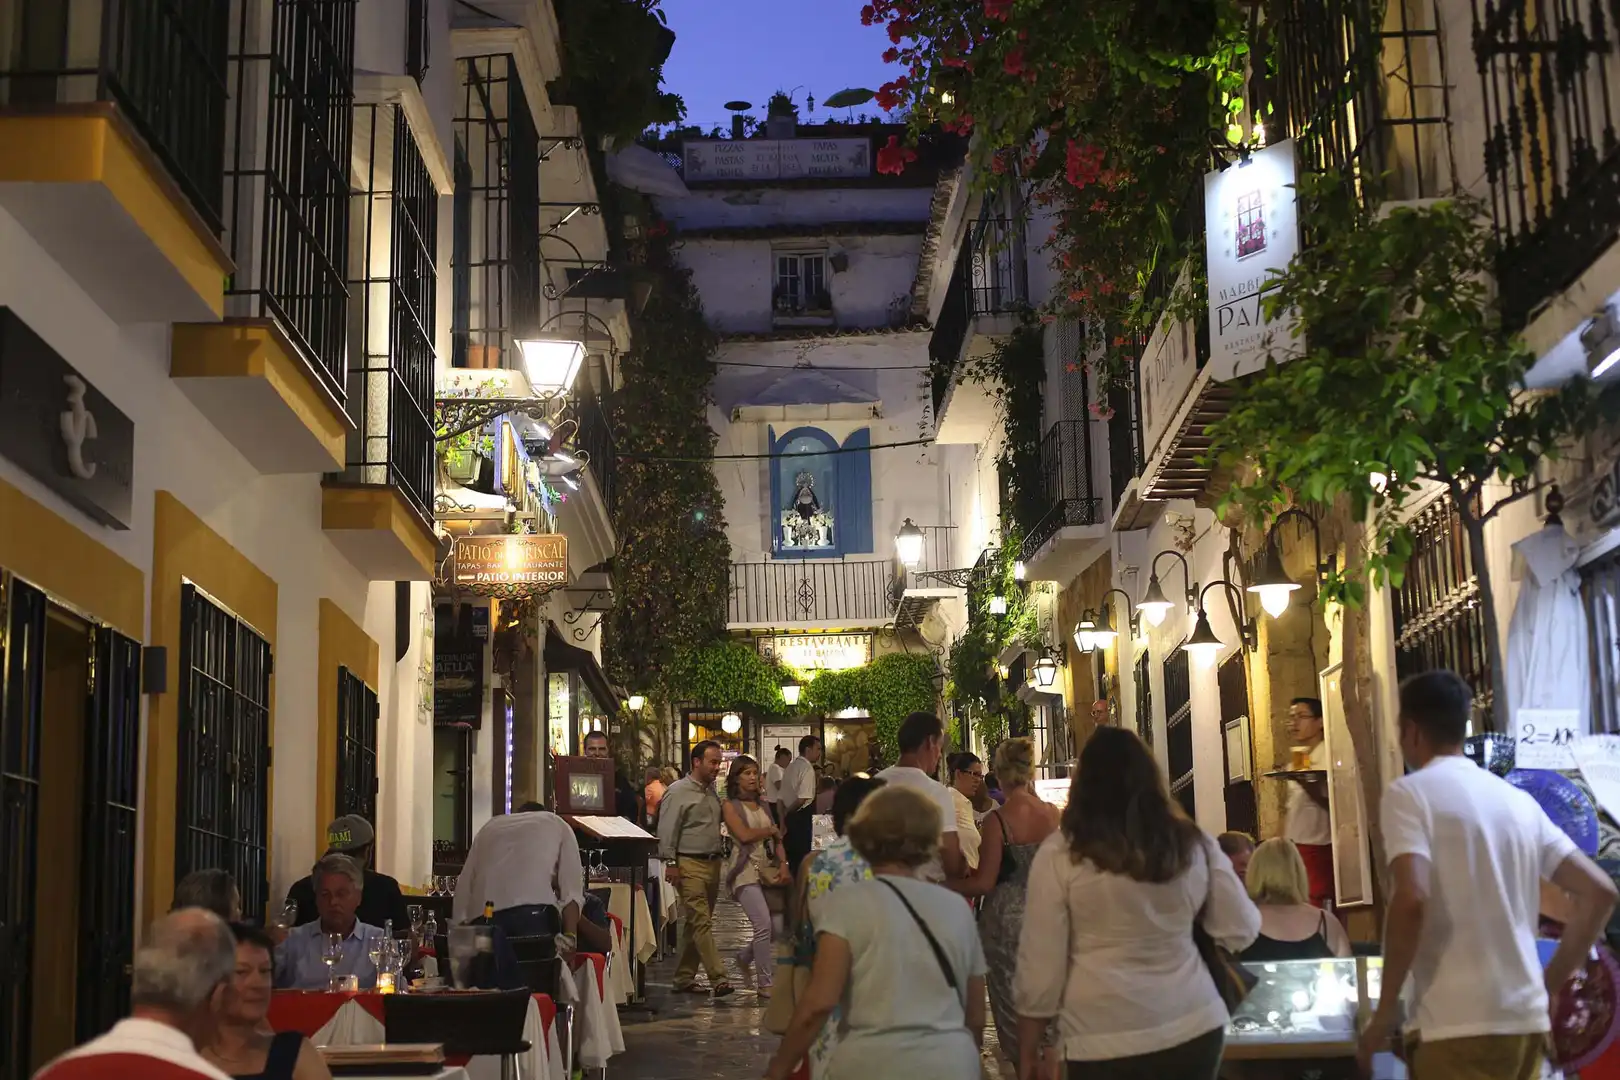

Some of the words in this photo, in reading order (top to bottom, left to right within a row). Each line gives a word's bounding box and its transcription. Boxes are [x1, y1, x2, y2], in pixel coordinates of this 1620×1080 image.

[714, 143, 745, 153] PIZZAS
[812, 142, 837, 151] TAPAS
[714, 155, 745, 165] PASTAS
[458, 542, 491, 560] PATIO
[514, 541, 564, 560] ARISCAL
[477, 571, 509, 582] PATIO
[512, 571, 564, 581] INTERIOR
[435, 661, 475, 672] AELLA
